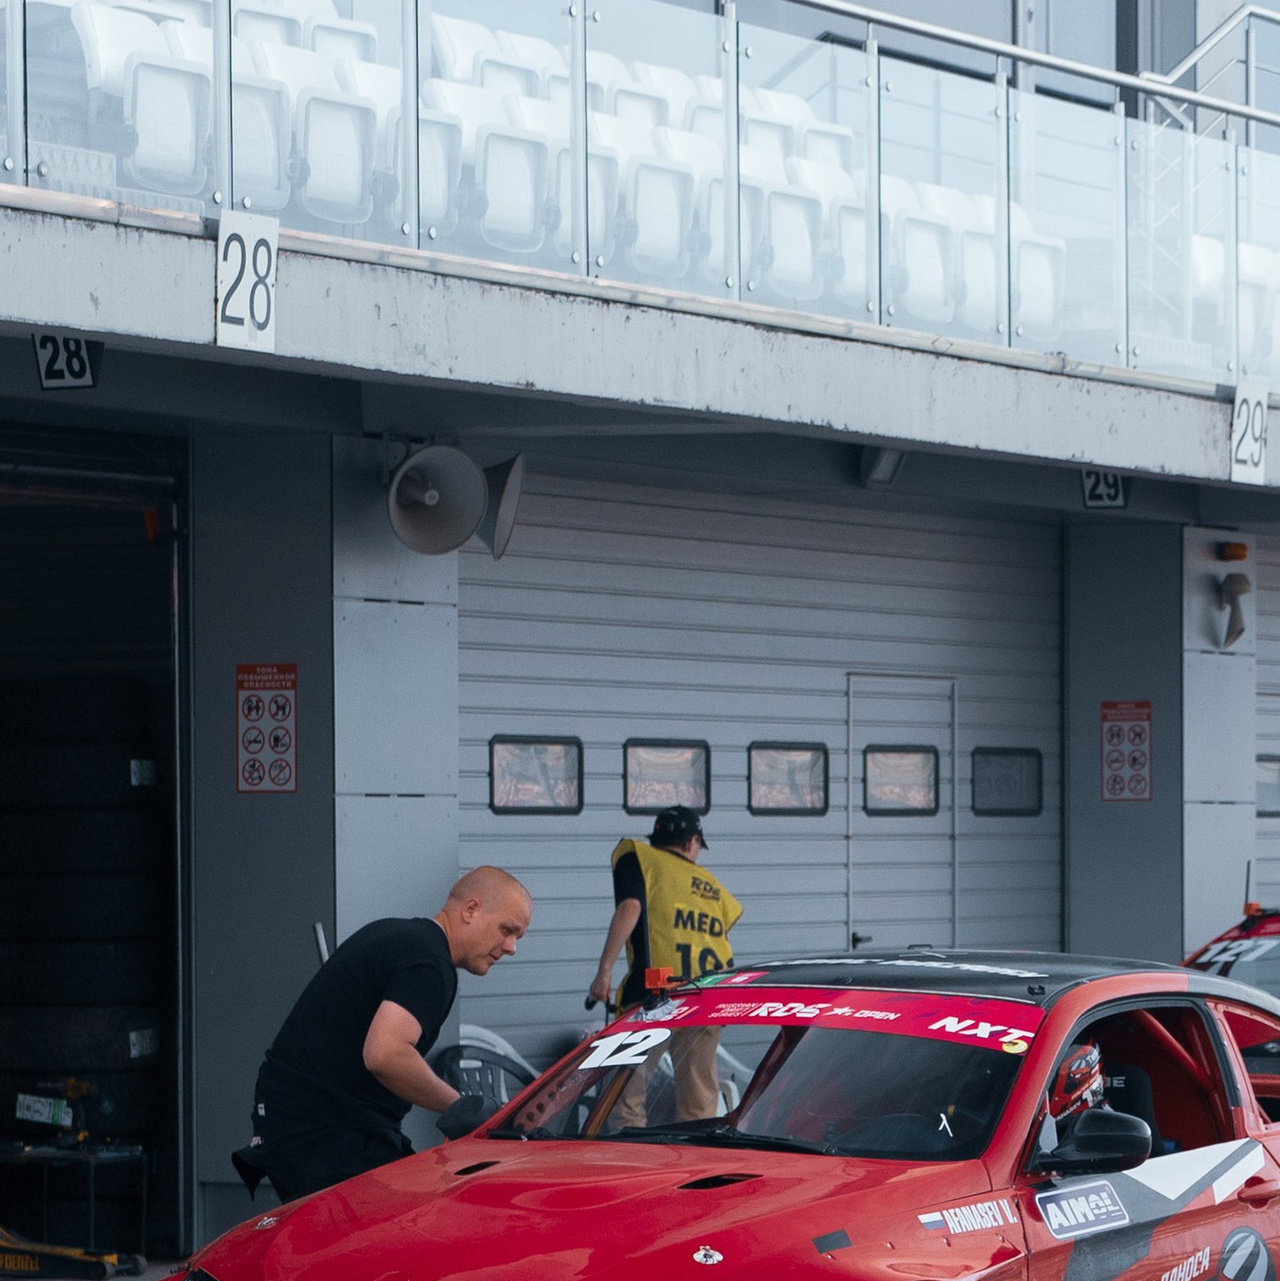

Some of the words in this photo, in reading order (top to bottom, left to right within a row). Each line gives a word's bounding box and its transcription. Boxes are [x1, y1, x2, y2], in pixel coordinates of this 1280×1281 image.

[220, 232, 273, 331] 28
[39, 334, 87, 380] 28
[1234, 397, 1265, 468] 29
[1085, 471, 1121, 502] 29
[673, 908, 724, 938] MED
[748, 1002, 832, 1018] RDS
[853, 1009, 901, 1021] OPEN
[928, 1016, 1035, 1042] NXT
[577, 1027, 672, 1070] 12
[942, 1200, 1003, 1235] AFANASEV
[997, 1198, 1018, 1223] V.
[1045, 1191, 1123, 1230] AIMOL
